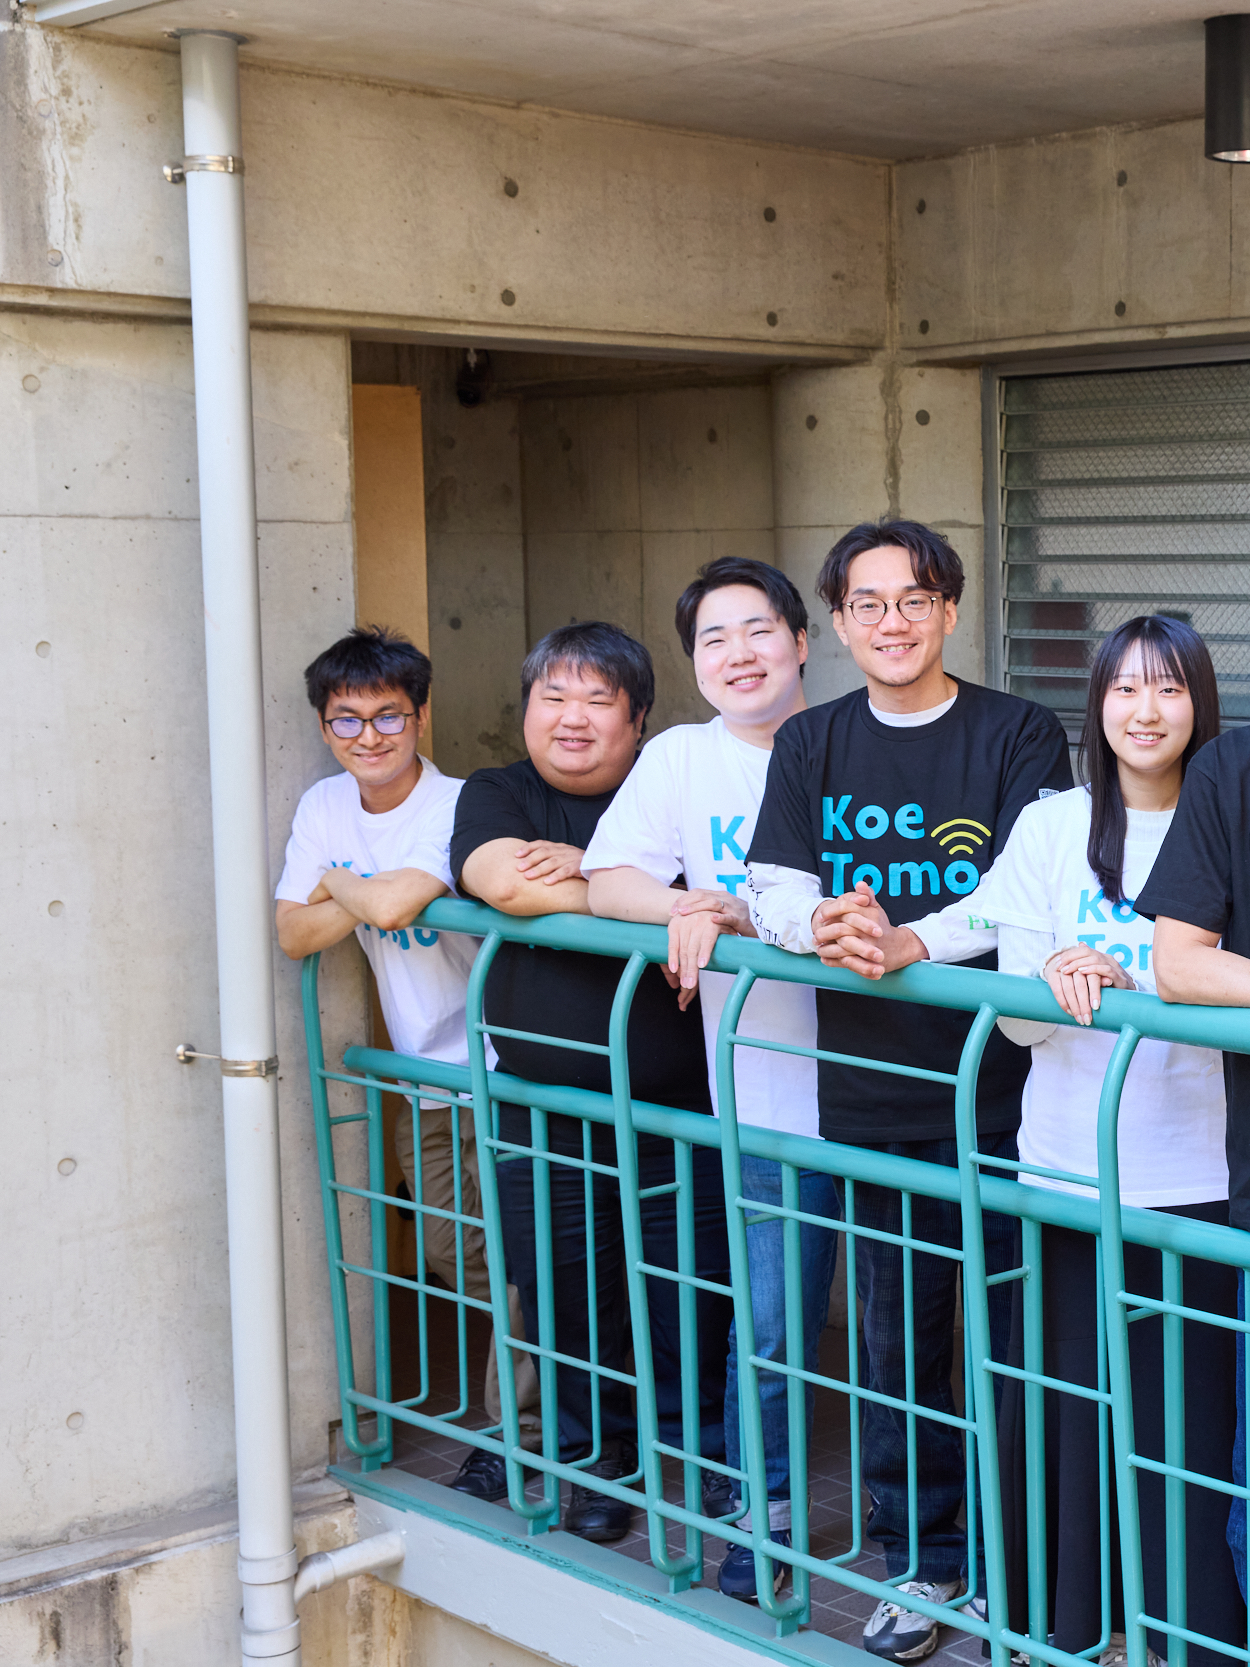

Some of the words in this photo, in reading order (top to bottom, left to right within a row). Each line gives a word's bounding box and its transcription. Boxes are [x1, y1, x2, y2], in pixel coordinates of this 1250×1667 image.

[822, 795, 926, 842] Koe
[821, 852, 980, 898] Tomo
[1077, 889, 1155, 924] Ko
